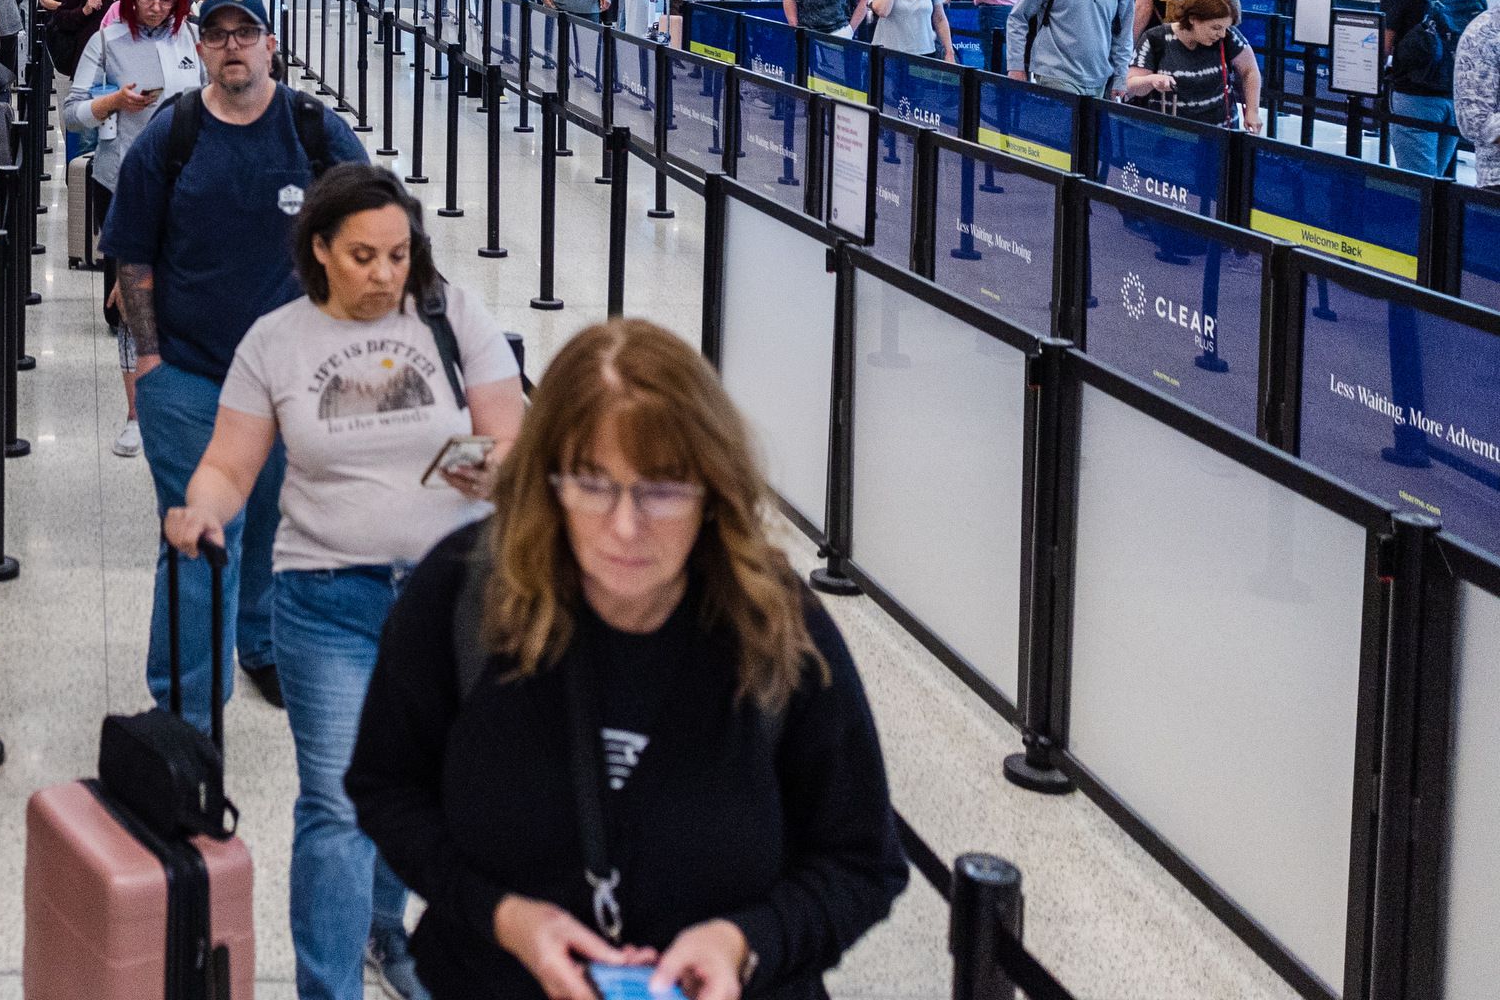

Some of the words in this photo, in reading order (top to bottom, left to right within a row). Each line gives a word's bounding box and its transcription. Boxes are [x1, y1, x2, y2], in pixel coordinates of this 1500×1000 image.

[952, 42, 980, 50] xploring
[764, 62, 783, 76] CLEAR
[914, 107, 941, 126] CLEAR
[1145, 177, 1187, 203] CLEAR
[956, 218, 969, 234] Less
[970, 223, 994, 248] Waiting,
[994, 234, 1011, 252] More
[1012, 240, 1032, 264] Doing
[1301, 228, 1339, 250] Welcome
[1341, 242, 1363, 258] Back
[1155, 296, 1215, 339] CLEAR
[1194, 335, 1214, 352] PLUS
[366, 340, 436, 378] BETTER
[1330, 373, 1355, 399] Less
[1357, 385, 1406, 424] Waiting,
[1409, 407, 1443, 438] More
[1399, 490, 1441, 516] clearme.com
